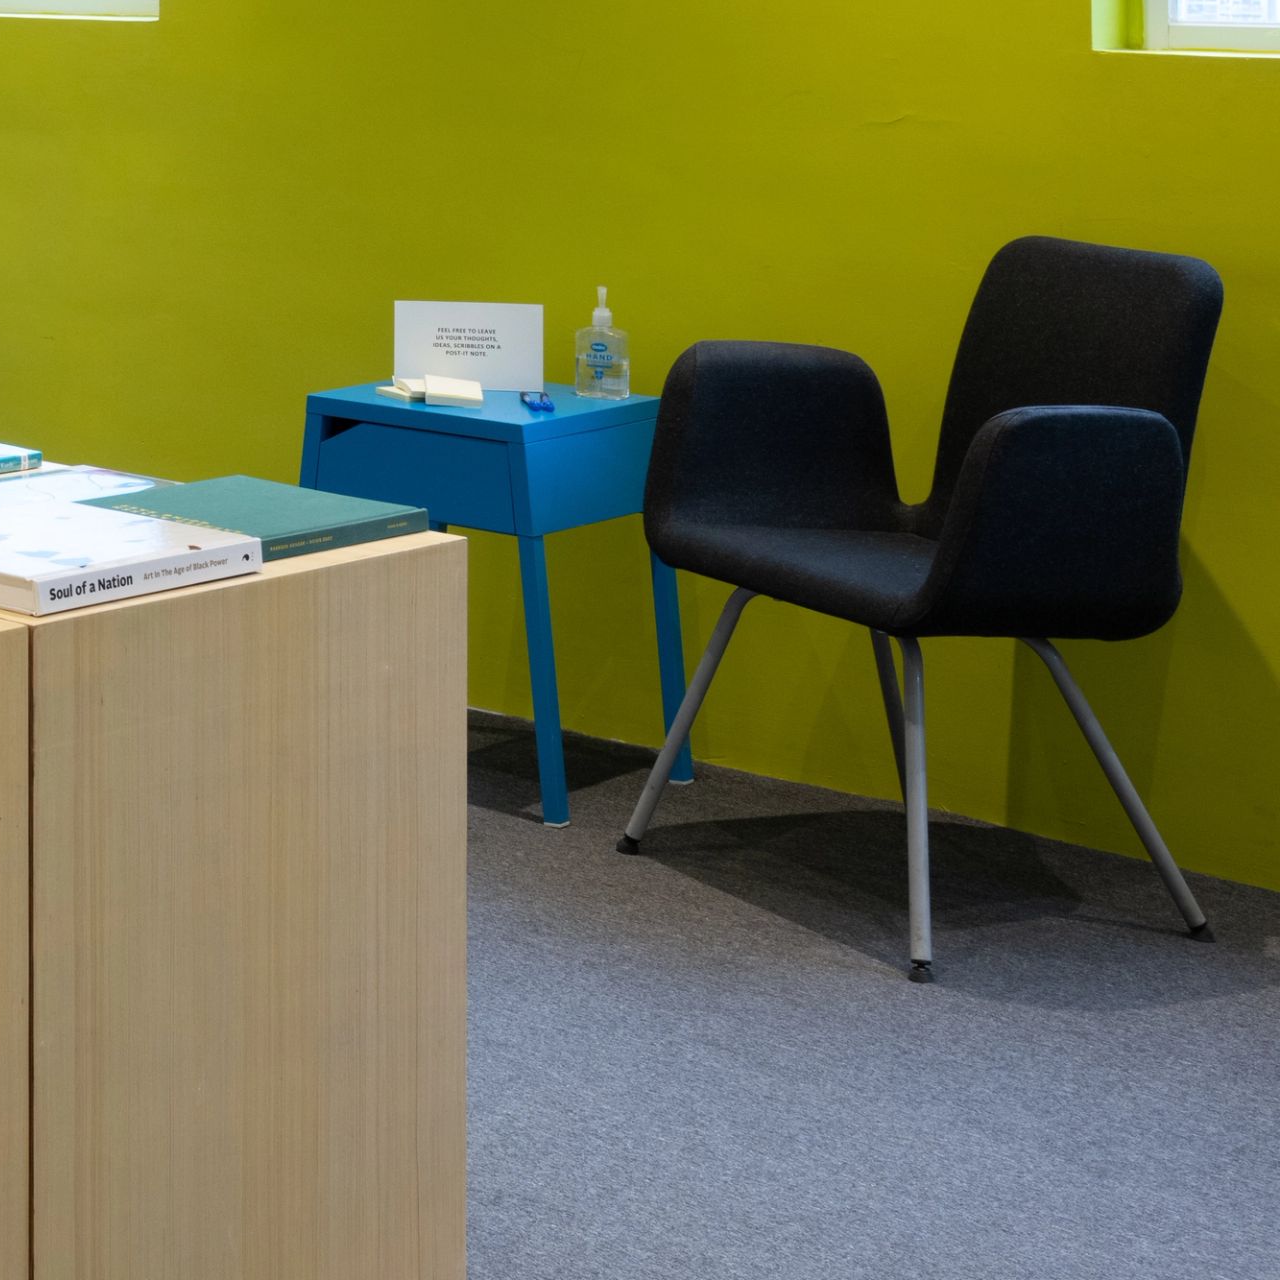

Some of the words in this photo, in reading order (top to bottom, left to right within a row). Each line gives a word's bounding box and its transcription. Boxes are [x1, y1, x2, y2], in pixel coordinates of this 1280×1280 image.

[586, 353, 613, 362] HAND
[49, 584, 73, 601] Soul
[75, 581, 88, 596] of
[89, 584, 96, 593] a
[97, 574, 133, 592] Nation
[143, 572, 153, 581] Art
[154, 571, 160, 579] In
[161, 569, 172, 578] The
[173, 567, 186, 577] Age
[186, 565, 192, 574] of
[193, 561, 209, 572] Black
[210, 558, 228, 569] Power
